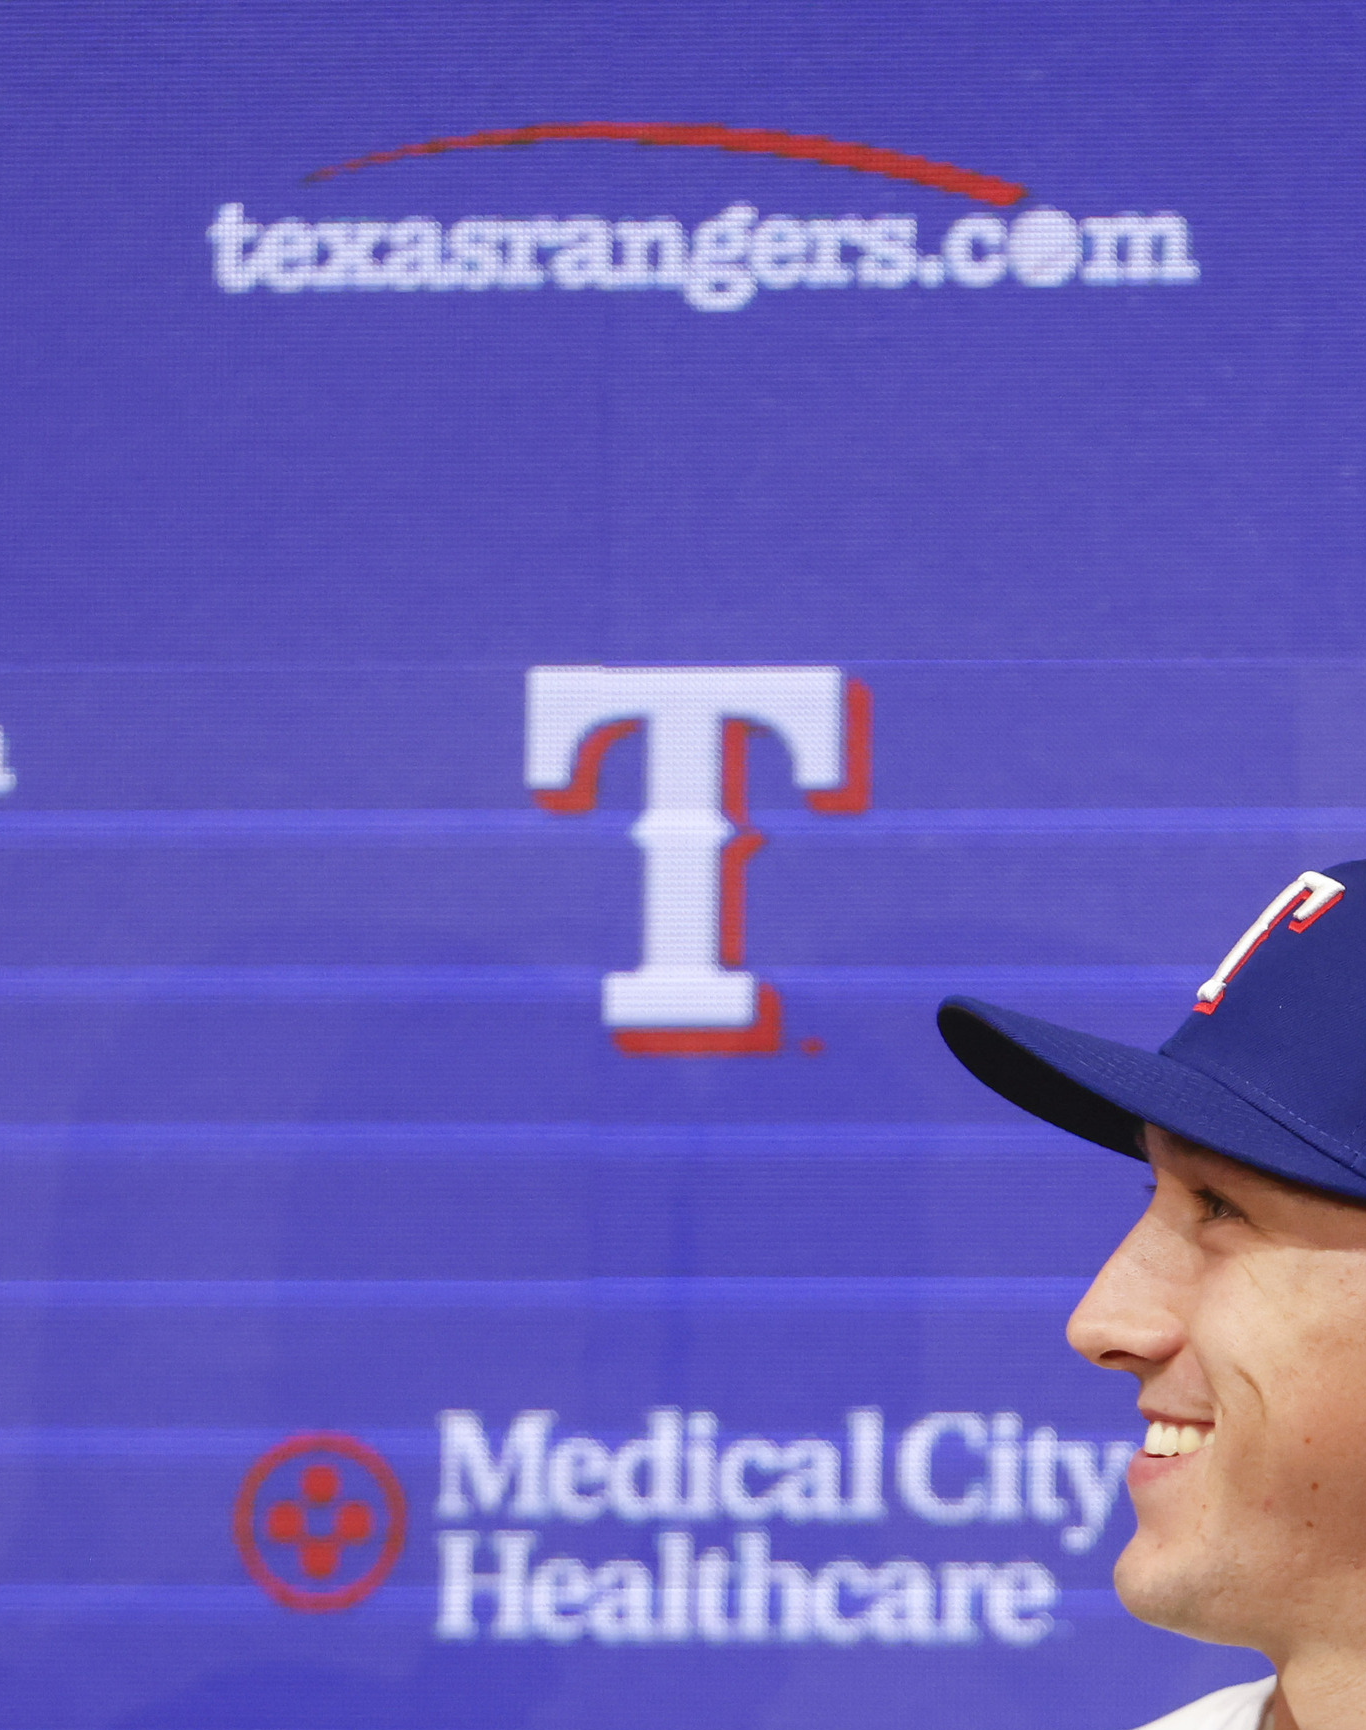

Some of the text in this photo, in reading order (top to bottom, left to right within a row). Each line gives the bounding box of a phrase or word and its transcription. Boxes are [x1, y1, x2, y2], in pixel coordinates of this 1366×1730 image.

[208, 203, 1201, 312] texasrangers.com
[523, 663, 872, 1056] T
[433, 1406, 1138, 1553] Medical City
[433, 1529, 1063, 1646] Healthcare
